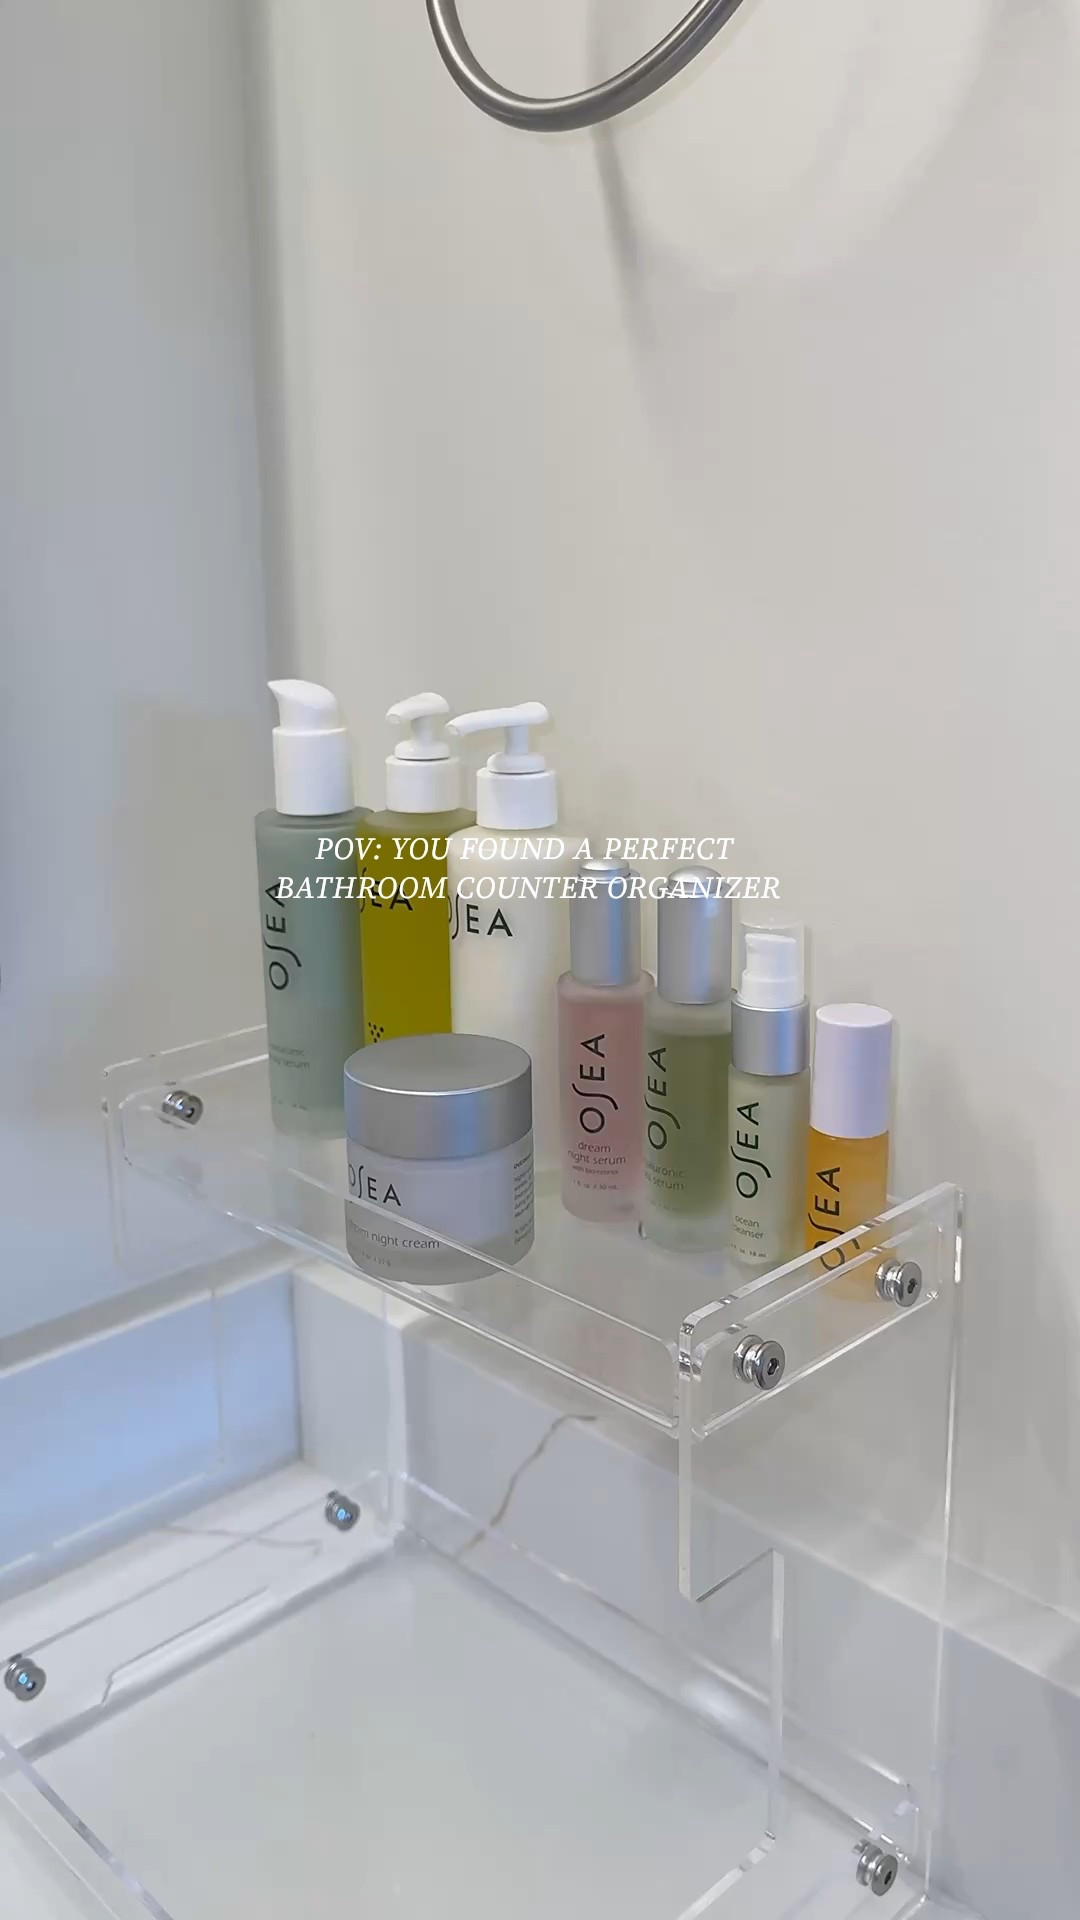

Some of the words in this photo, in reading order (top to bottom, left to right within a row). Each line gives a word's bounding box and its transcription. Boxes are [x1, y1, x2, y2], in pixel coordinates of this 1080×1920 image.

[360, 867, 413, 913] SEA
[264, 882, 303, 991] OSEA
[571, 1033, 619, 1135] OSEA
[644, 1046, 681, 1151] OSEA
[567, 1150, 590, 1164] night
[593, 1155, 627, 1166] serum
[578, 1142, 612, 1153] dream
[730, 1101, 772, 1199] OSEA
[371, 1232, 400, 1248] night
[402, 1239, 441, 1250] cream
[735, 1216, 760, 1229] ocean
[807, 1166, 861, 1272] OSEA
